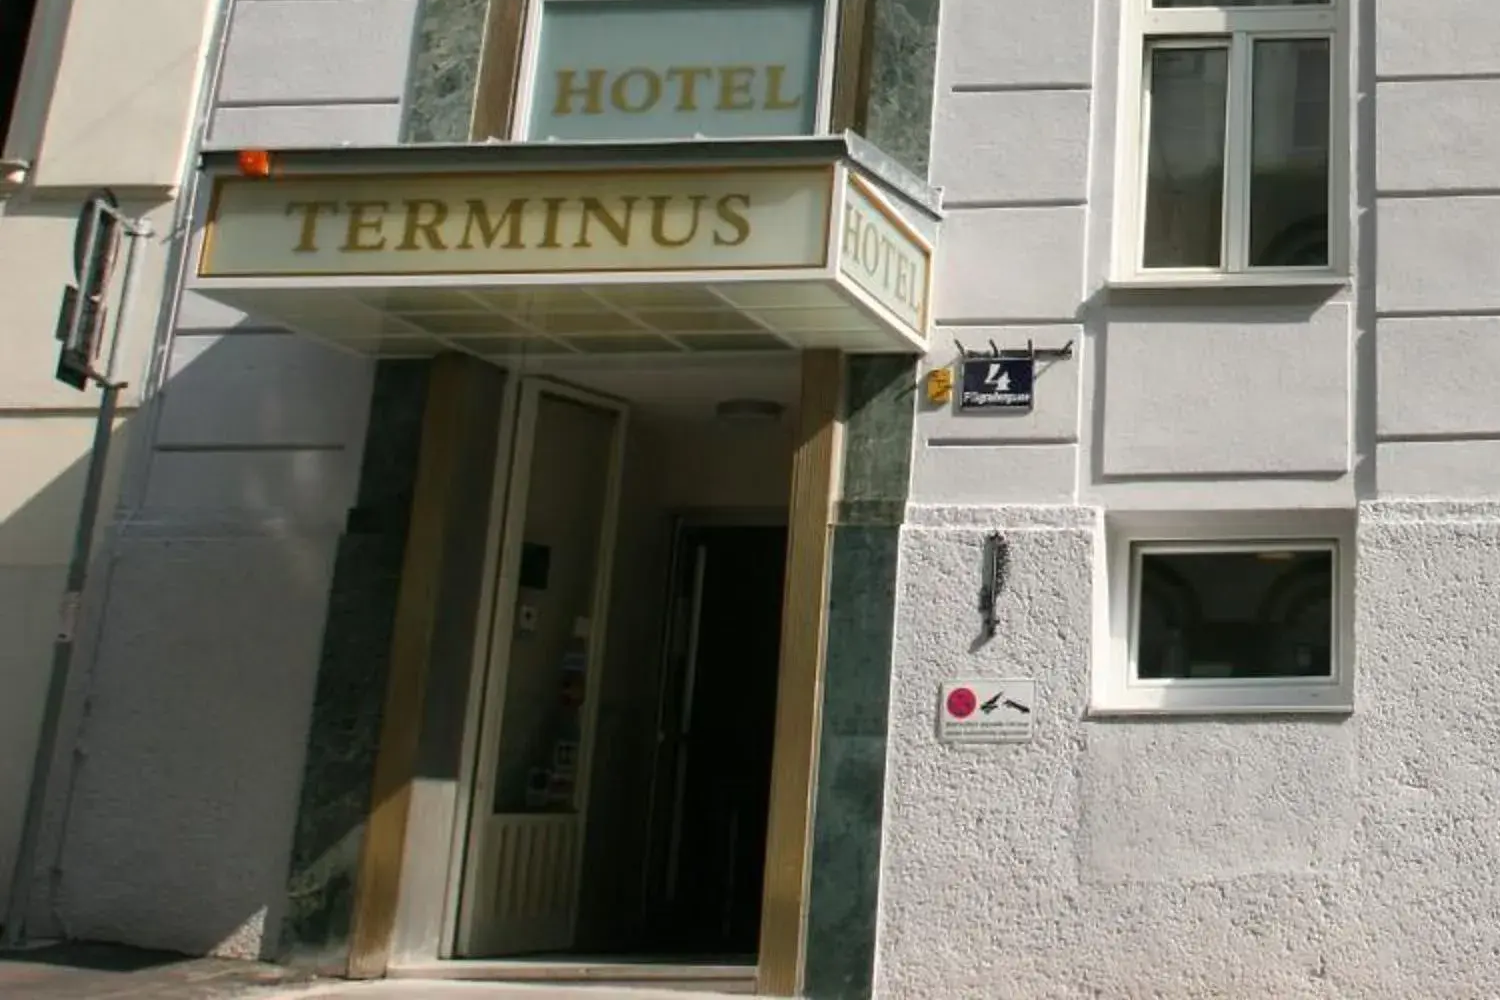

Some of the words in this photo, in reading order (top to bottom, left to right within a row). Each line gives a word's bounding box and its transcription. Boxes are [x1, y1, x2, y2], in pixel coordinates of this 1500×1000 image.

[551, 63, 804, 118] HOTEL
[284, 192, 752, 254] TERMINUS
[842, 202, 921, 313] HOTEL
[983, 362, 1012, 391] 4
